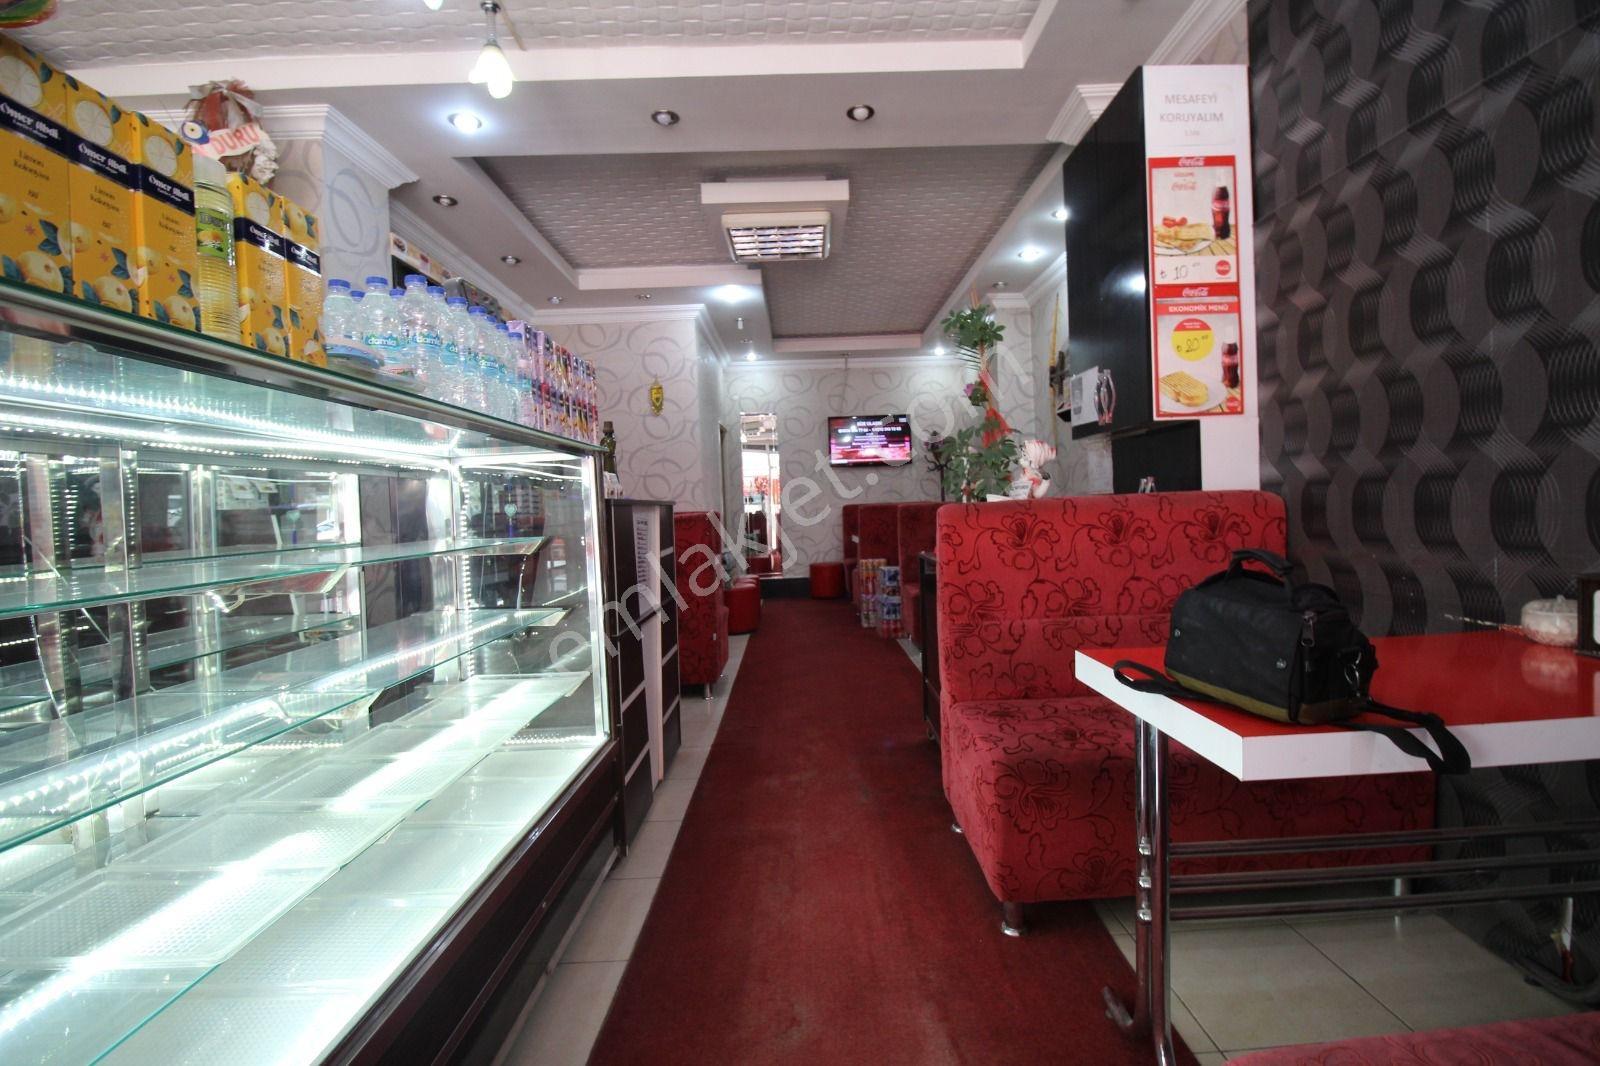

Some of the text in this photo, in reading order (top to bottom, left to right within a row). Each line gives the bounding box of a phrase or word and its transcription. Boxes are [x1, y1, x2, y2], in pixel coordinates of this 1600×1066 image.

[1164, 92, 1218, 104] MESAFEYİ
[1160, 112, 1224, 122] KORUYALIM
[211, 124, 260, 154] DURU
[368, 337, 397, 347] damla
